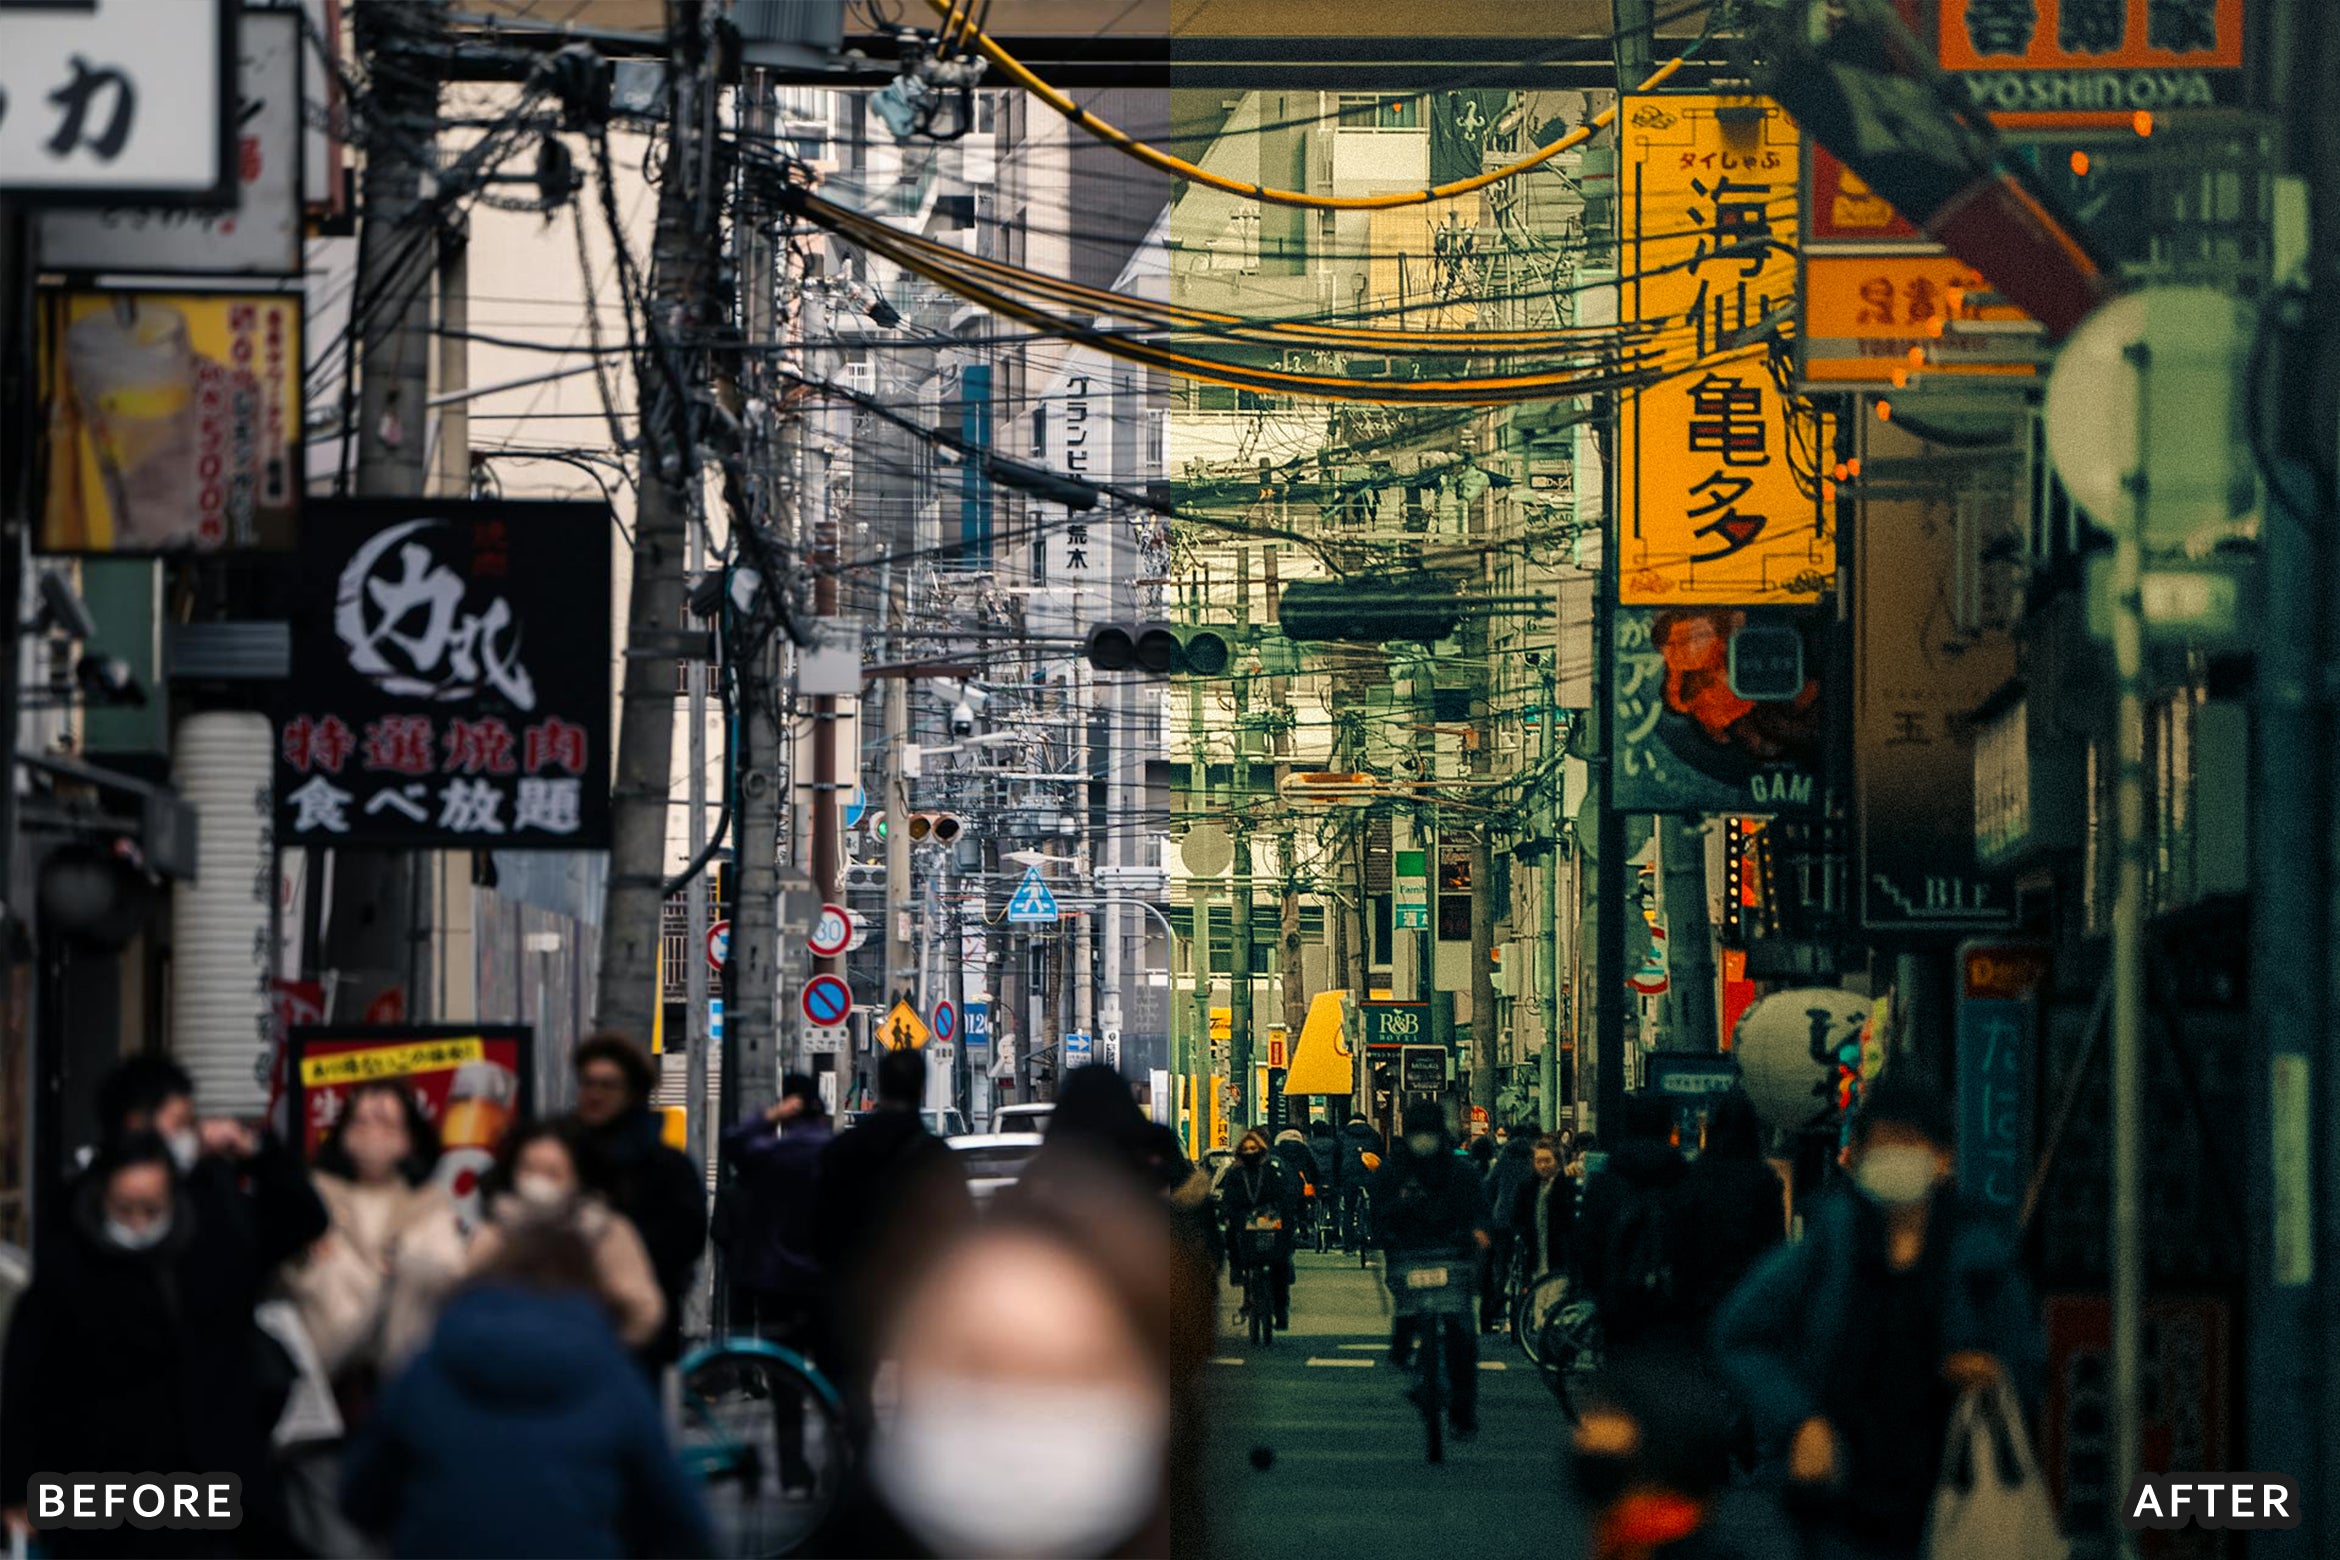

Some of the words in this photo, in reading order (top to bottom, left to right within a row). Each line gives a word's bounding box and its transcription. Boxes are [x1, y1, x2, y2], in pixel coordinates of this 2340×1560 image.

[1964, 73, 2214, 109] YOSHINOYA
[1066, 376, 1088, 569] グランビ荒木
[283, 714, 588, 775] 特選焼肉
[288, 776, 583, 834] 食べ放題
[813, 919, 842, 942] 30
[1379, 1013, 1419, 1035] R&B
